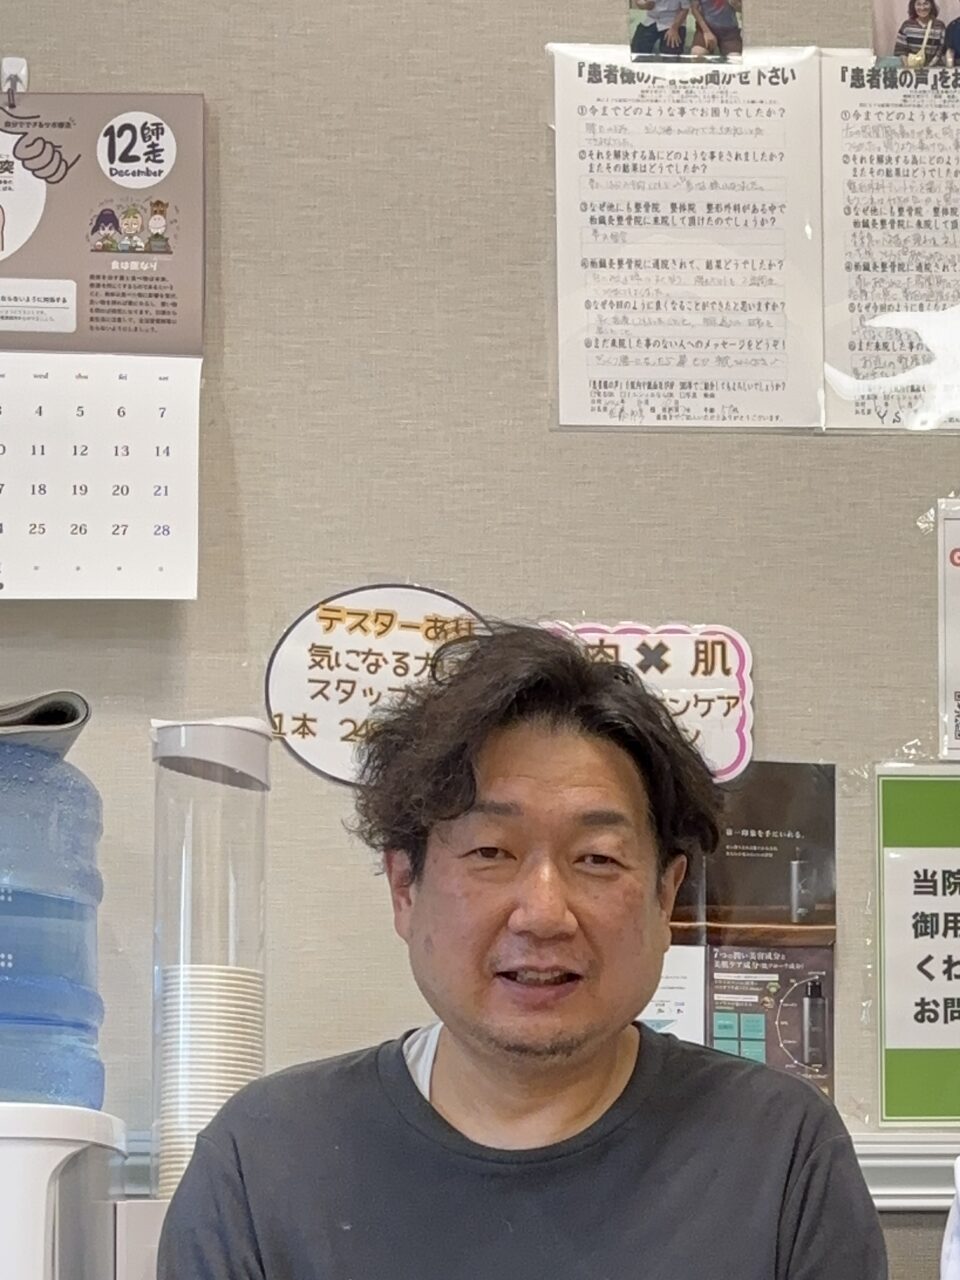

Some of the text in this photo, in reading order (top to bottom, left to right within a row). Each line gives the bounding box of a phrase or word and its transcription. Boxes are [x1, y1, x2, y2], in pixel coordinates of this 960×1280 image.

[103, 123, 141, 165] 12
[140, 121, 165, 164] 師走
[109, 167, 163, 177] December
[35, 405, 167, 418] 4 5 6 7
[31, 444, 171, 457] 11 12 13 14
[31, 484, 169, 497] 18 19 20 21
[29, 523, 171, 536] 25 26 27 28
[691, 640, 732, 676] 肌
[666, 694, 740, 717] ンケア
[272, 713, 317, 739] 1本
